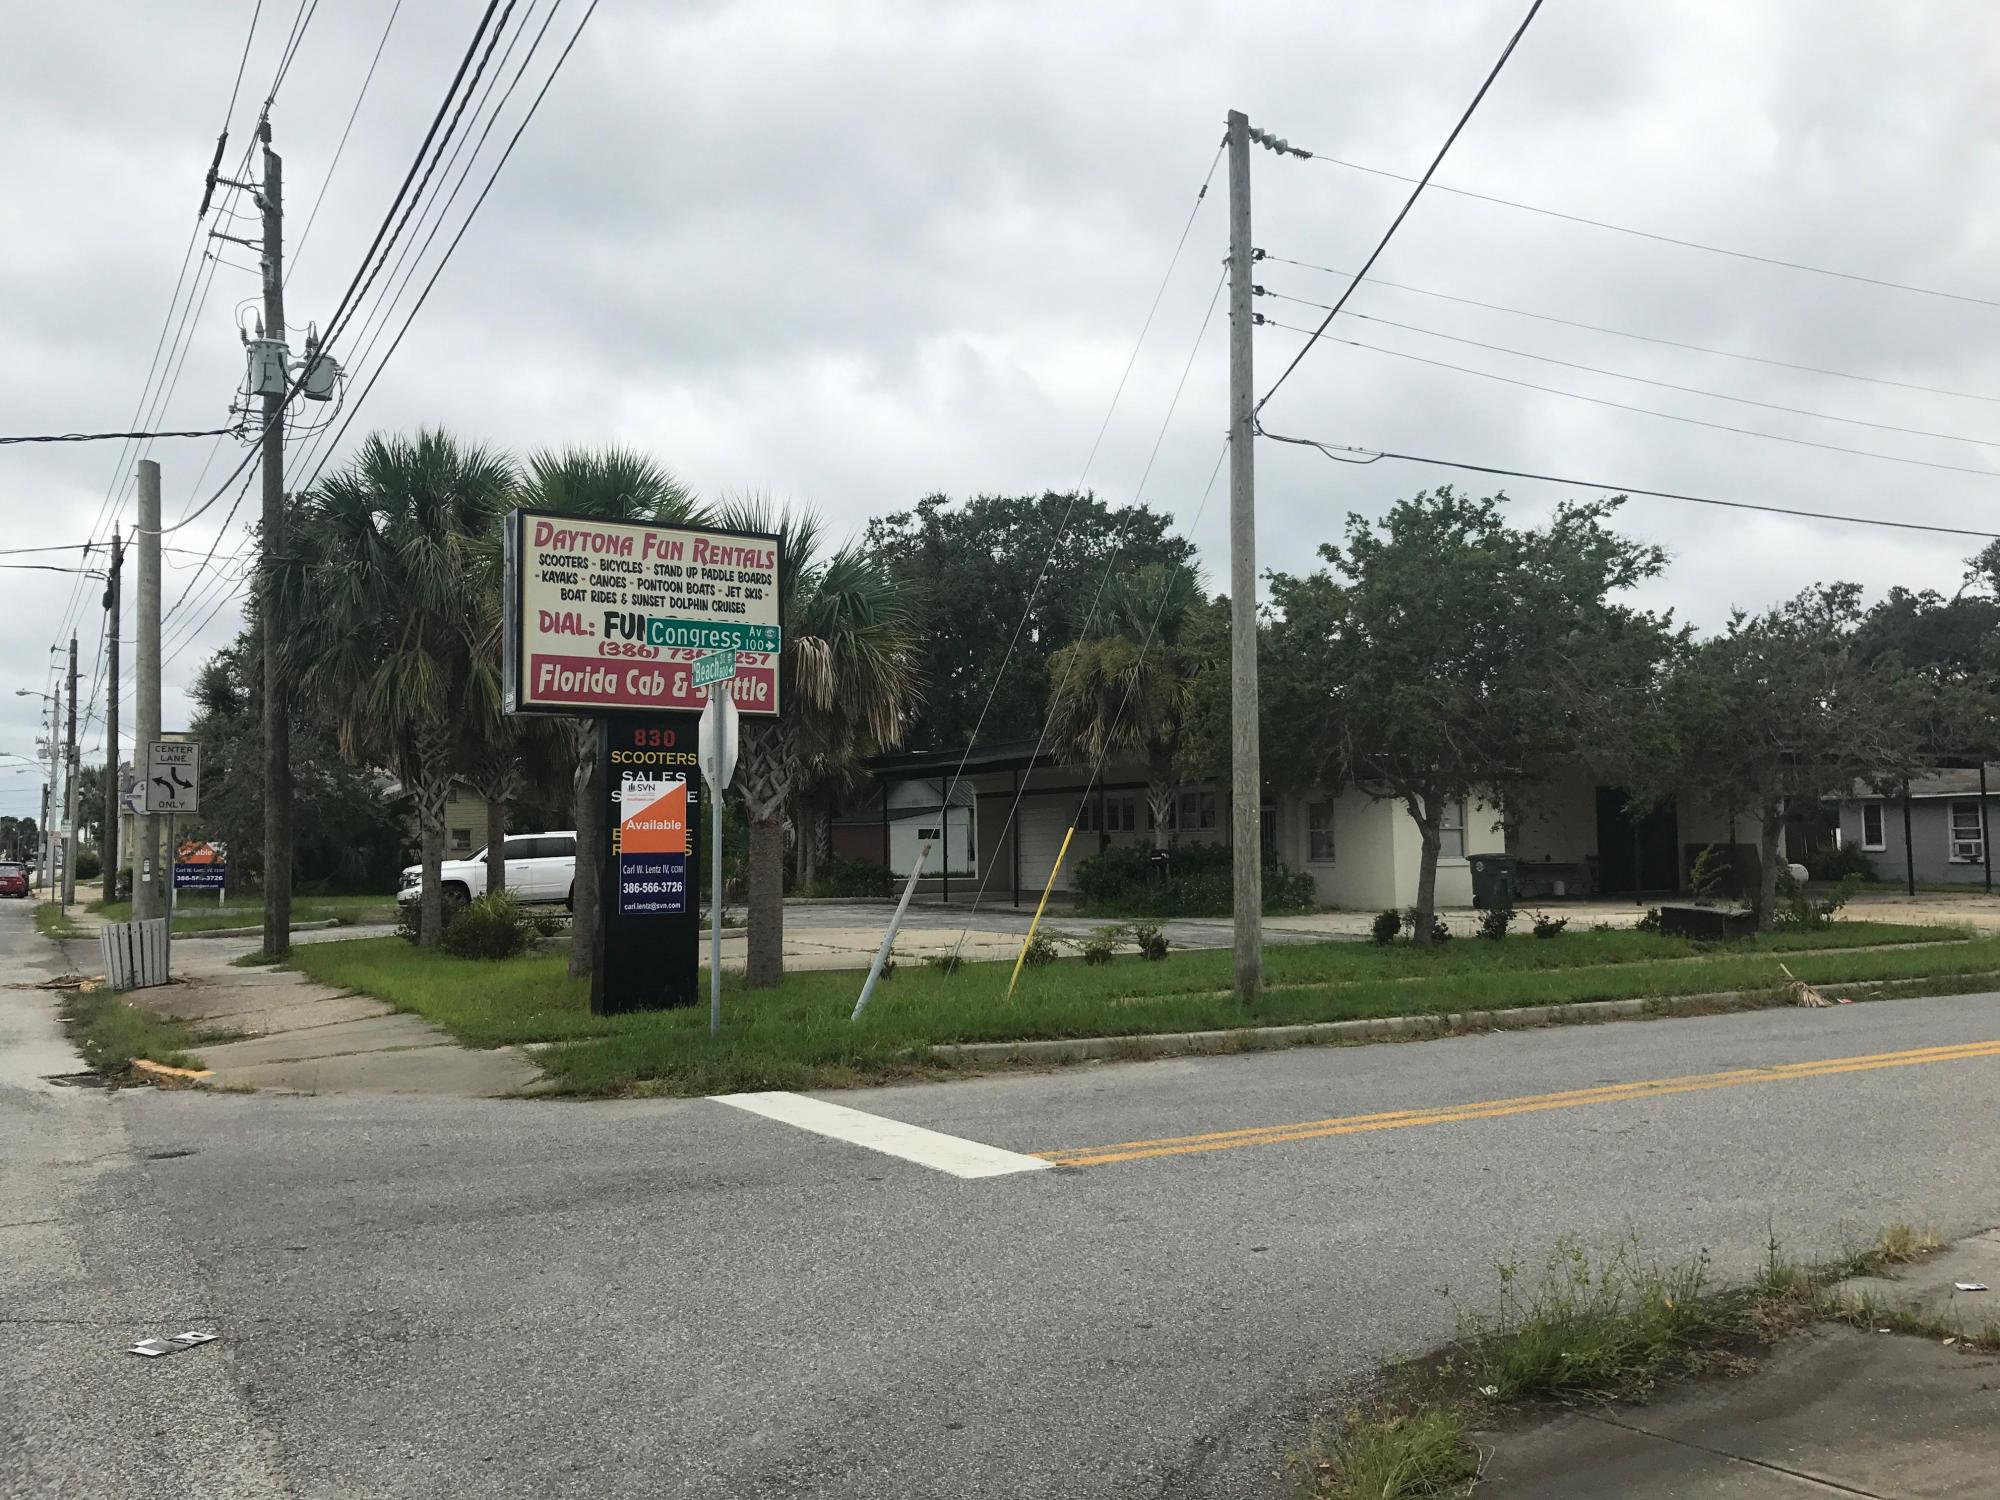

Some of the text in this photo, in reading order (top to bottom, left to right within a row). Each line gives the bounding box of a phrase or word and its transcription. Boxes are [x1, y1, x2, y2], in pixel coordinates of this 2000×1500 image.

[534, 521, 775, 569] DAYTONA FUN RENTALS
[539, 553, 588, 569] SCOOTERS
[600, 559, 642, 574] BICYCLES
[654, 564, 682, 578] STAND
[686, 567, 698, 578] UP
[702, 568, 734, 582] PADDLE
[738, 572, 772, 585] BOARDS
[542, 570, 578, 585] KAYAKS
[590, 574, 626, 588] CANOES
[637, 578, 683, 593] PONTOON
[687, 582, 715, 596] BOATS
[725, 586, 741, 598] JET
[745, 587, 762, 600] SKIS
[561, 588, 746, 614] BOAT RIDES & SUNSET DOLPHIN CRUISES
[539, 610, 595, 636] DIAL:
[749, 627, 762, 637] Av
[652, 622, 741, 648] Congress
[746, 640, 764, 650] 100
[598, 641, 660, 659] (386)
[539, 664, 618, 694] Florida
[626, 669, 665, 696] Cab
[672, 671, 688, 698] &
[696, 657, 719, 683] Beach
[634, 729, 676, 747] 830
[611, 751, 697, 765] SCOOTERS
[626, 820, 681, 830] Available
[623, 865, 635, 874] Carl
[637, 865, 644, 873] W.
[646, 865, 661, 873] Lentz
[623, 882, 682, 893] 386-566-3726
